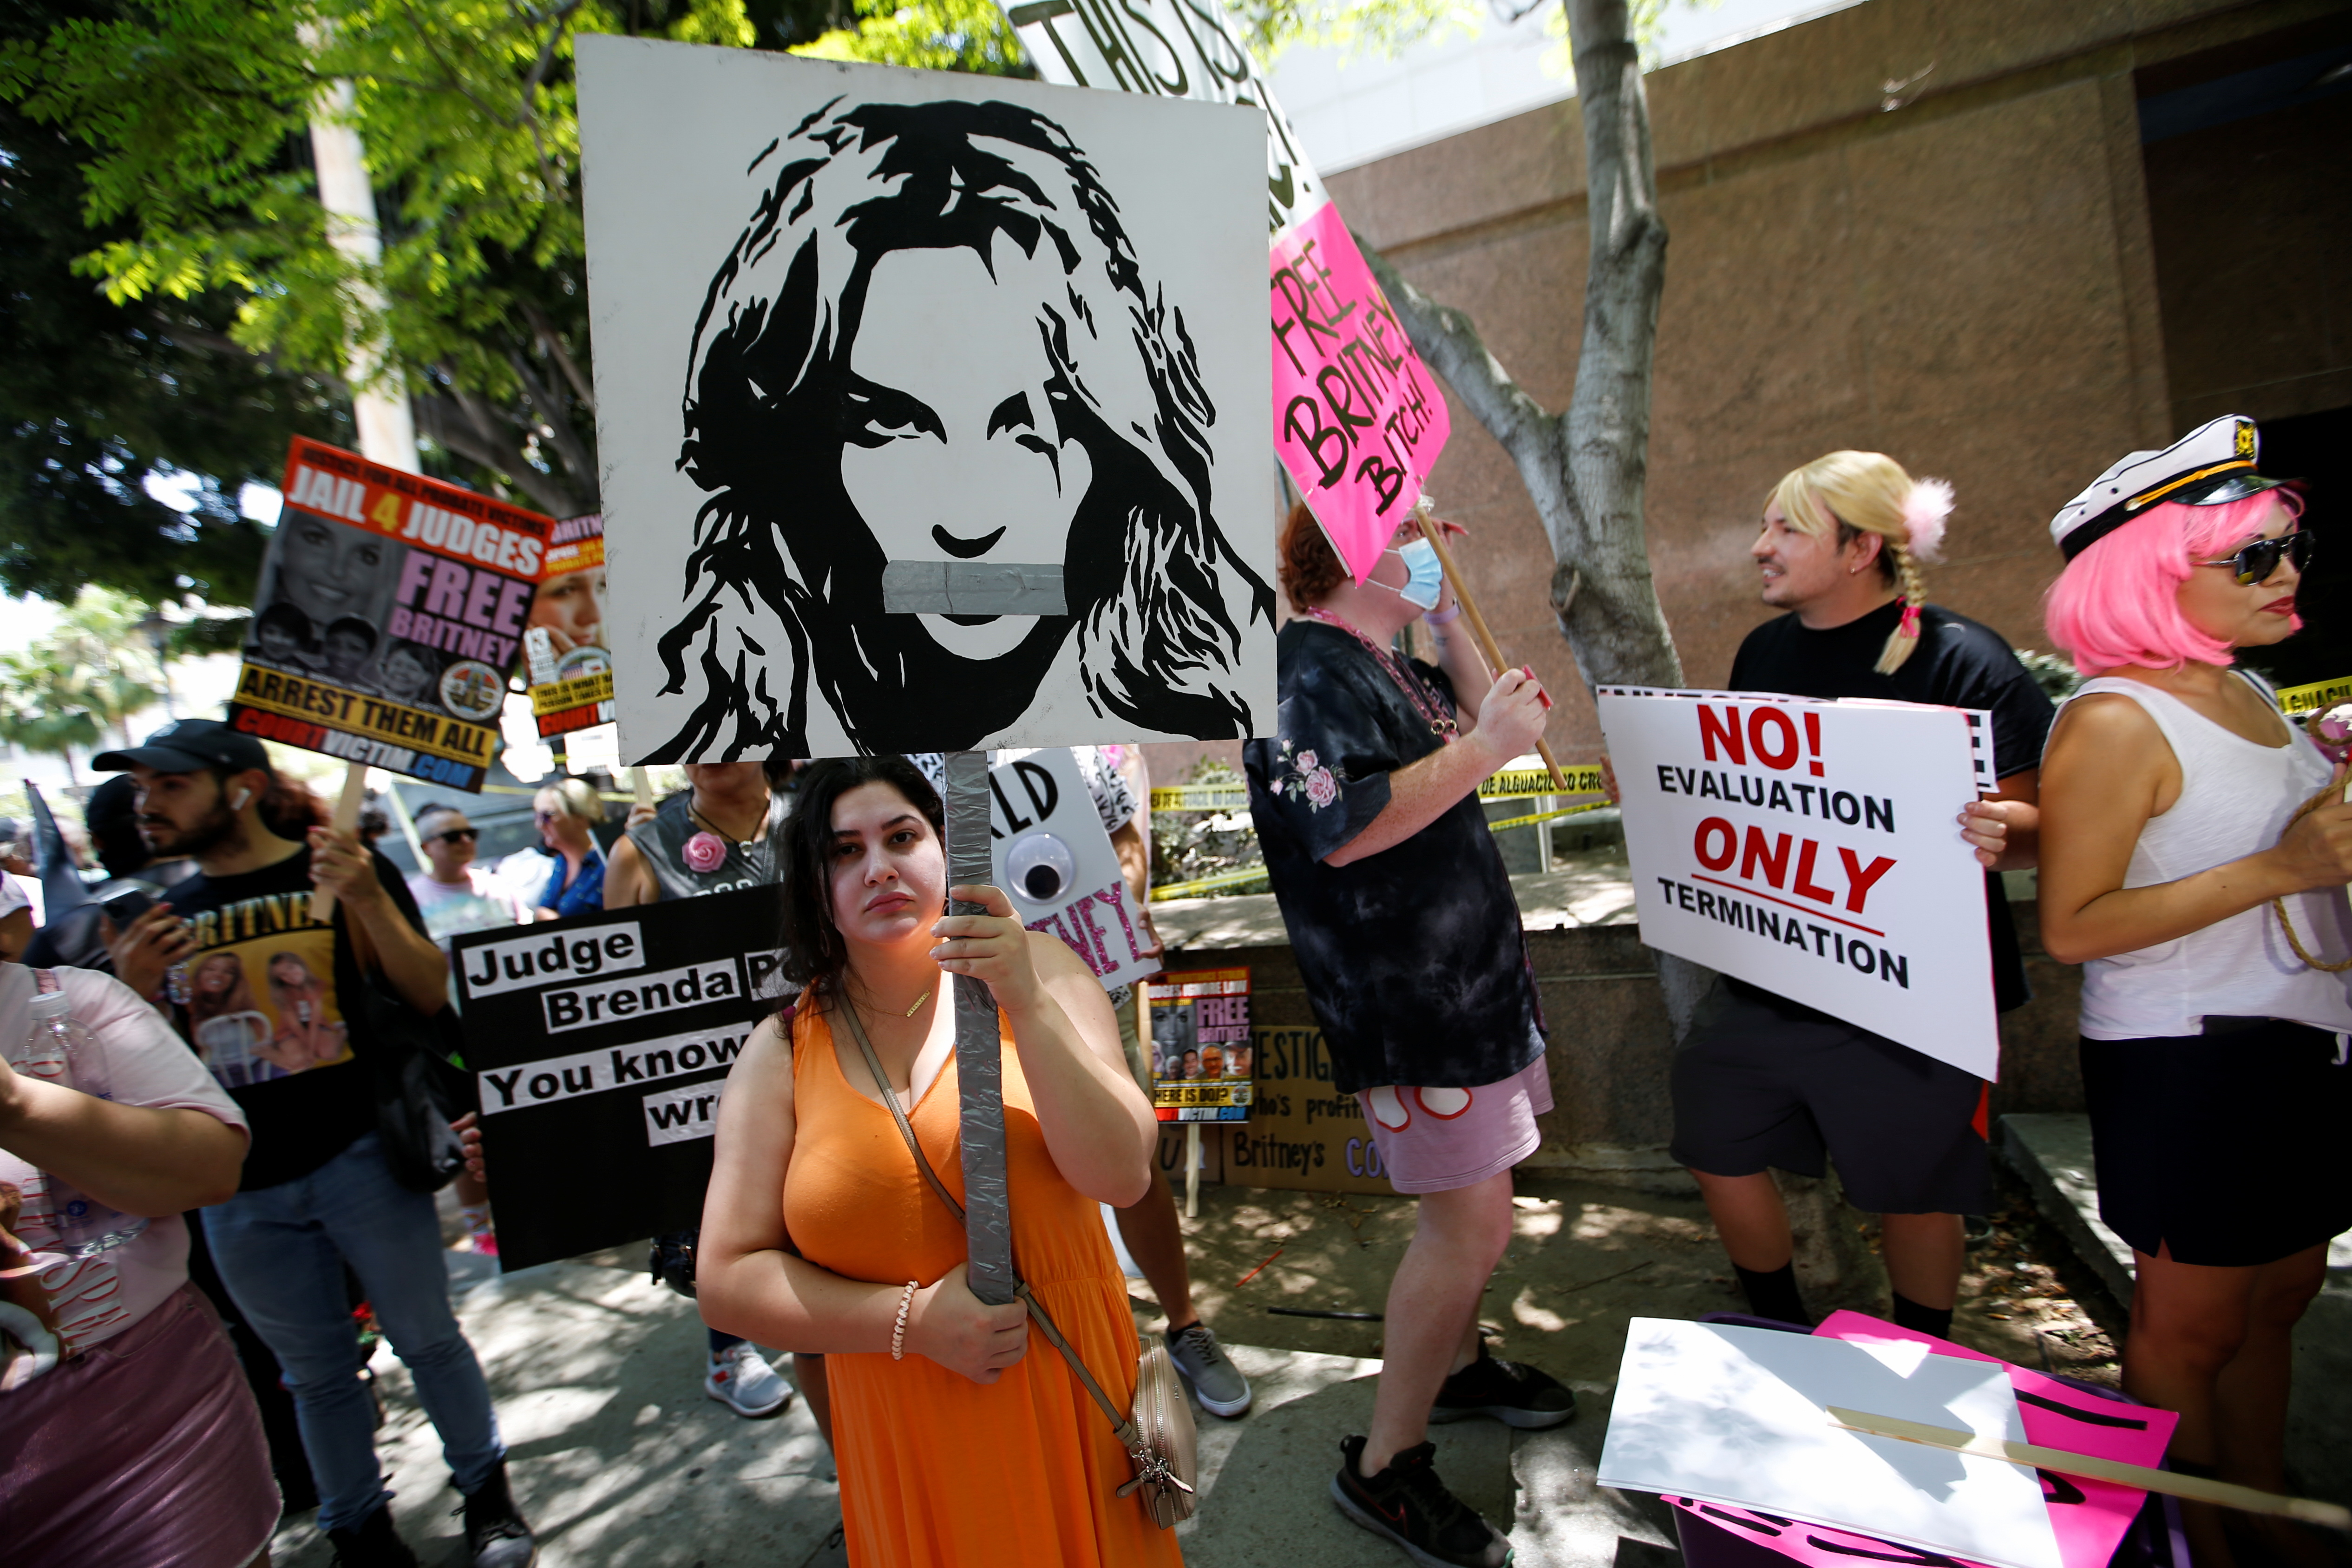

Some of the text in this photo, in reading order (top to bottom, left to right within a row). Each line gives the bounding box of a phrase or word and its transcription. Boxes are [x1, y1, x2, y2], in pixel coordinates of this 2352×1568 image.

[1271, 239, 1357, 378] FREE
[1284, 295, 1417, 490] BRITNEY
[1355, 364, 1433, 517] BITCH!
[287, 464, 544, 577] JAIL 4 JUDGES
[550, 512, 603, 545] BRITN
[396, 549, 531, 638] FREE
[388, 606, 518, 669] BRITNEY
[524, 627, 550, 652] 13
[241, 668, 356, 721] ARREST
[361, 698, 439, 743] THEM
[440, 722, 486, 757] ALL
[538, 700, 615, 736] COURTVI
[1697, 704, 1825, 778] NO!
[235, 707, 476, 789] COURTVICTIM.COM
[1482, 776, 1495, 794] DE
[1500, 774, 1554, 794] ALGUACIL
[1657, 764, 1895, 833] EVALUATION
[1694, 816, 1898, 915] ONLY
[470, 932, 635, 987] Judge
[1658, 877, 1909, 990] TERMINATION
[547, 968, 734, 1028] Brenda
[1148, 984, 1181, 999] UDGES
[1223, 980, 1247, 994] LAW
[1197, 997, 1250, 1027] FREE
[1198, 1025, 1250, 1043] BRITNEY
[485, 1065, 593, 1107] You
[648, 1094, 720, 1130] wr
[1155, 1088, 1182, 1102] HERE
[1186, 1088, 1196, 1102] IS
[1306, 1093, 1365, 1125] profit
[1233, 1130, 1389, 1180] Britney's CO
